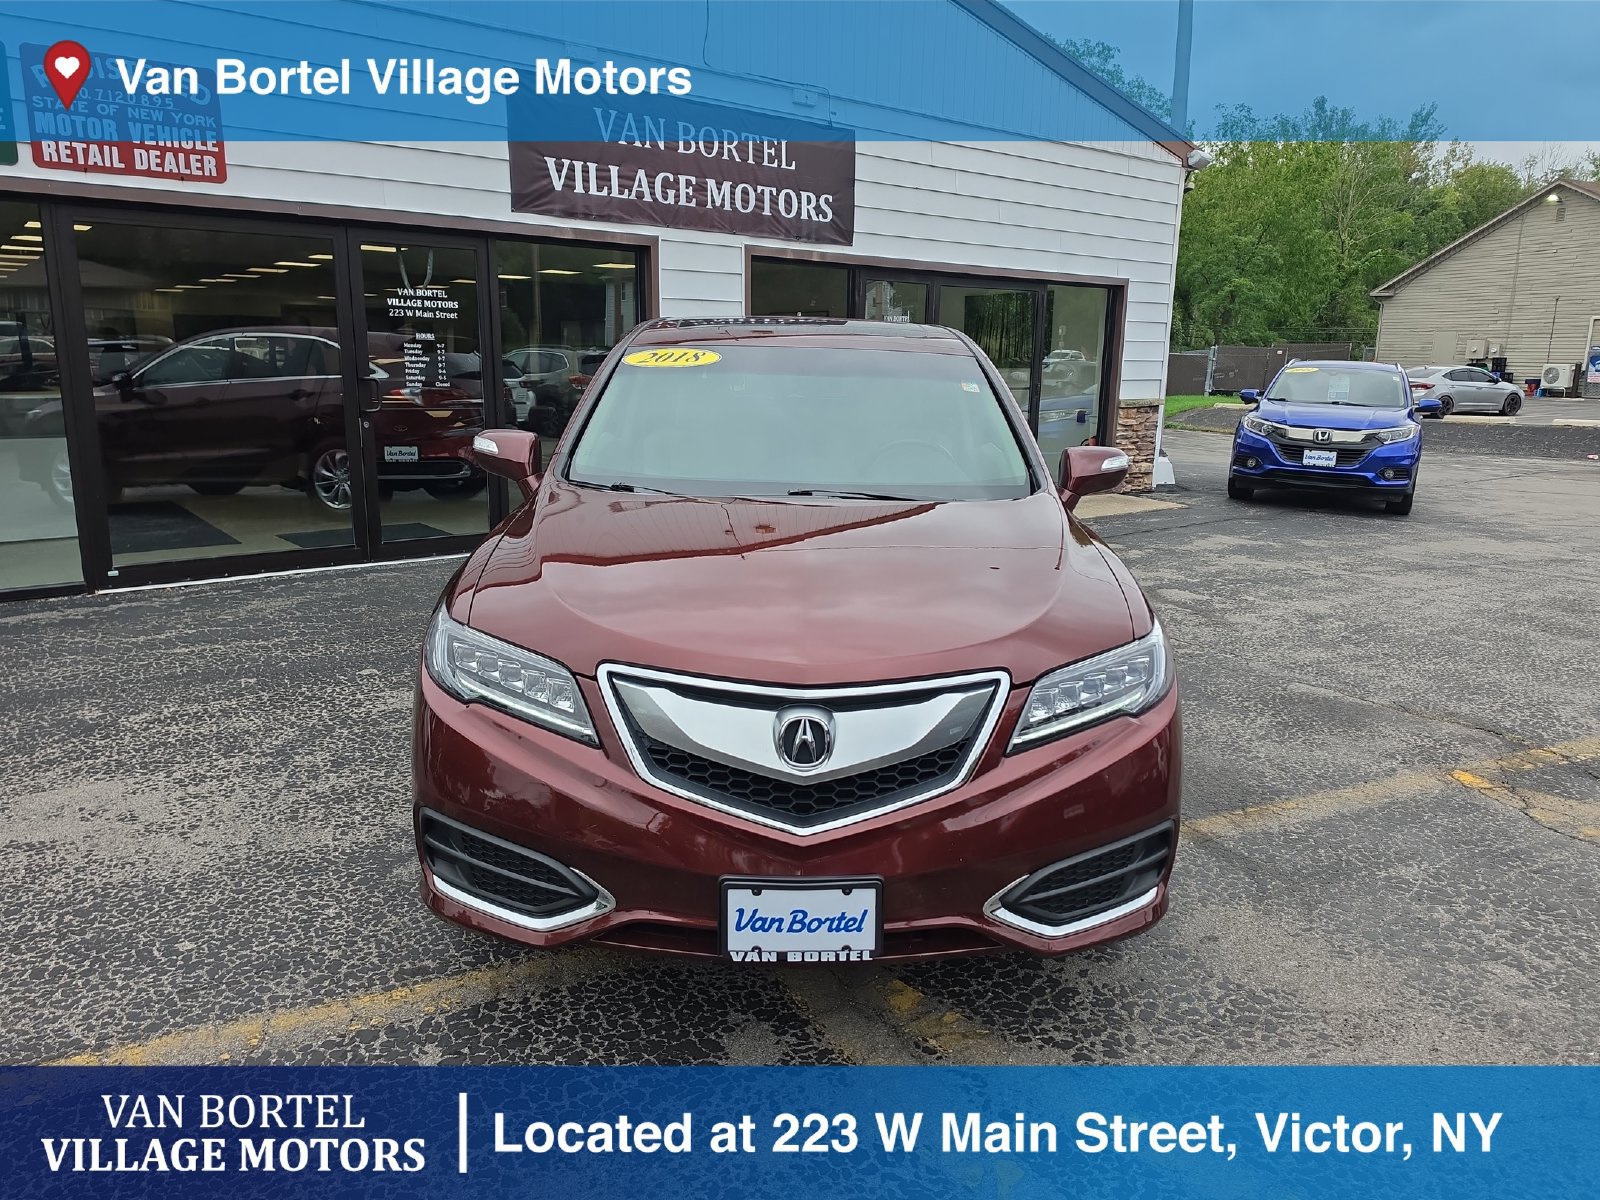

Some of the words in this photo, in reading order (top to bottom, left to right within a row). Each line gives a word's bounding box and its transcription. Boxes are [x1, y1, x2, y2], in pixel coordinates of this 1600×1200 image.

[96, 103, 120, 116] OF
[127, 106, 163, 122] NEW
[171, 111, 217, 128] YORK
[34, 111, 119, 142] MOTOR
[128, 121, 219, 153] VEHICLE
[593, 106, 666, 151] VAN
[677, 121, 797, 170] BORTEL
[41, 139, 126, 169] RETAIL
[134, 148, 218, 177] DEALER
[544, 156, 697, 208] VILLAGE
[705, 178, 834, 223] MOTORS
[397, 287, 414, 297] VAN
[416, 288, 448, 298] BORTEL
[387, 298, 423, 308] VILLAGE
[423, 300, 459, 309] MOTORS
[389, 308, 405, 317] 223
[406, 309, 414, 317] W
[415, 309, 435, 318] Main
[435, 310, 458, 319] Street
[415, 332, 435, 340] HOURS
[637, 351, 706, 364] 2018
[729, 951, 778, 963] VAN
[787, 949, 874, 963] BORTEL
